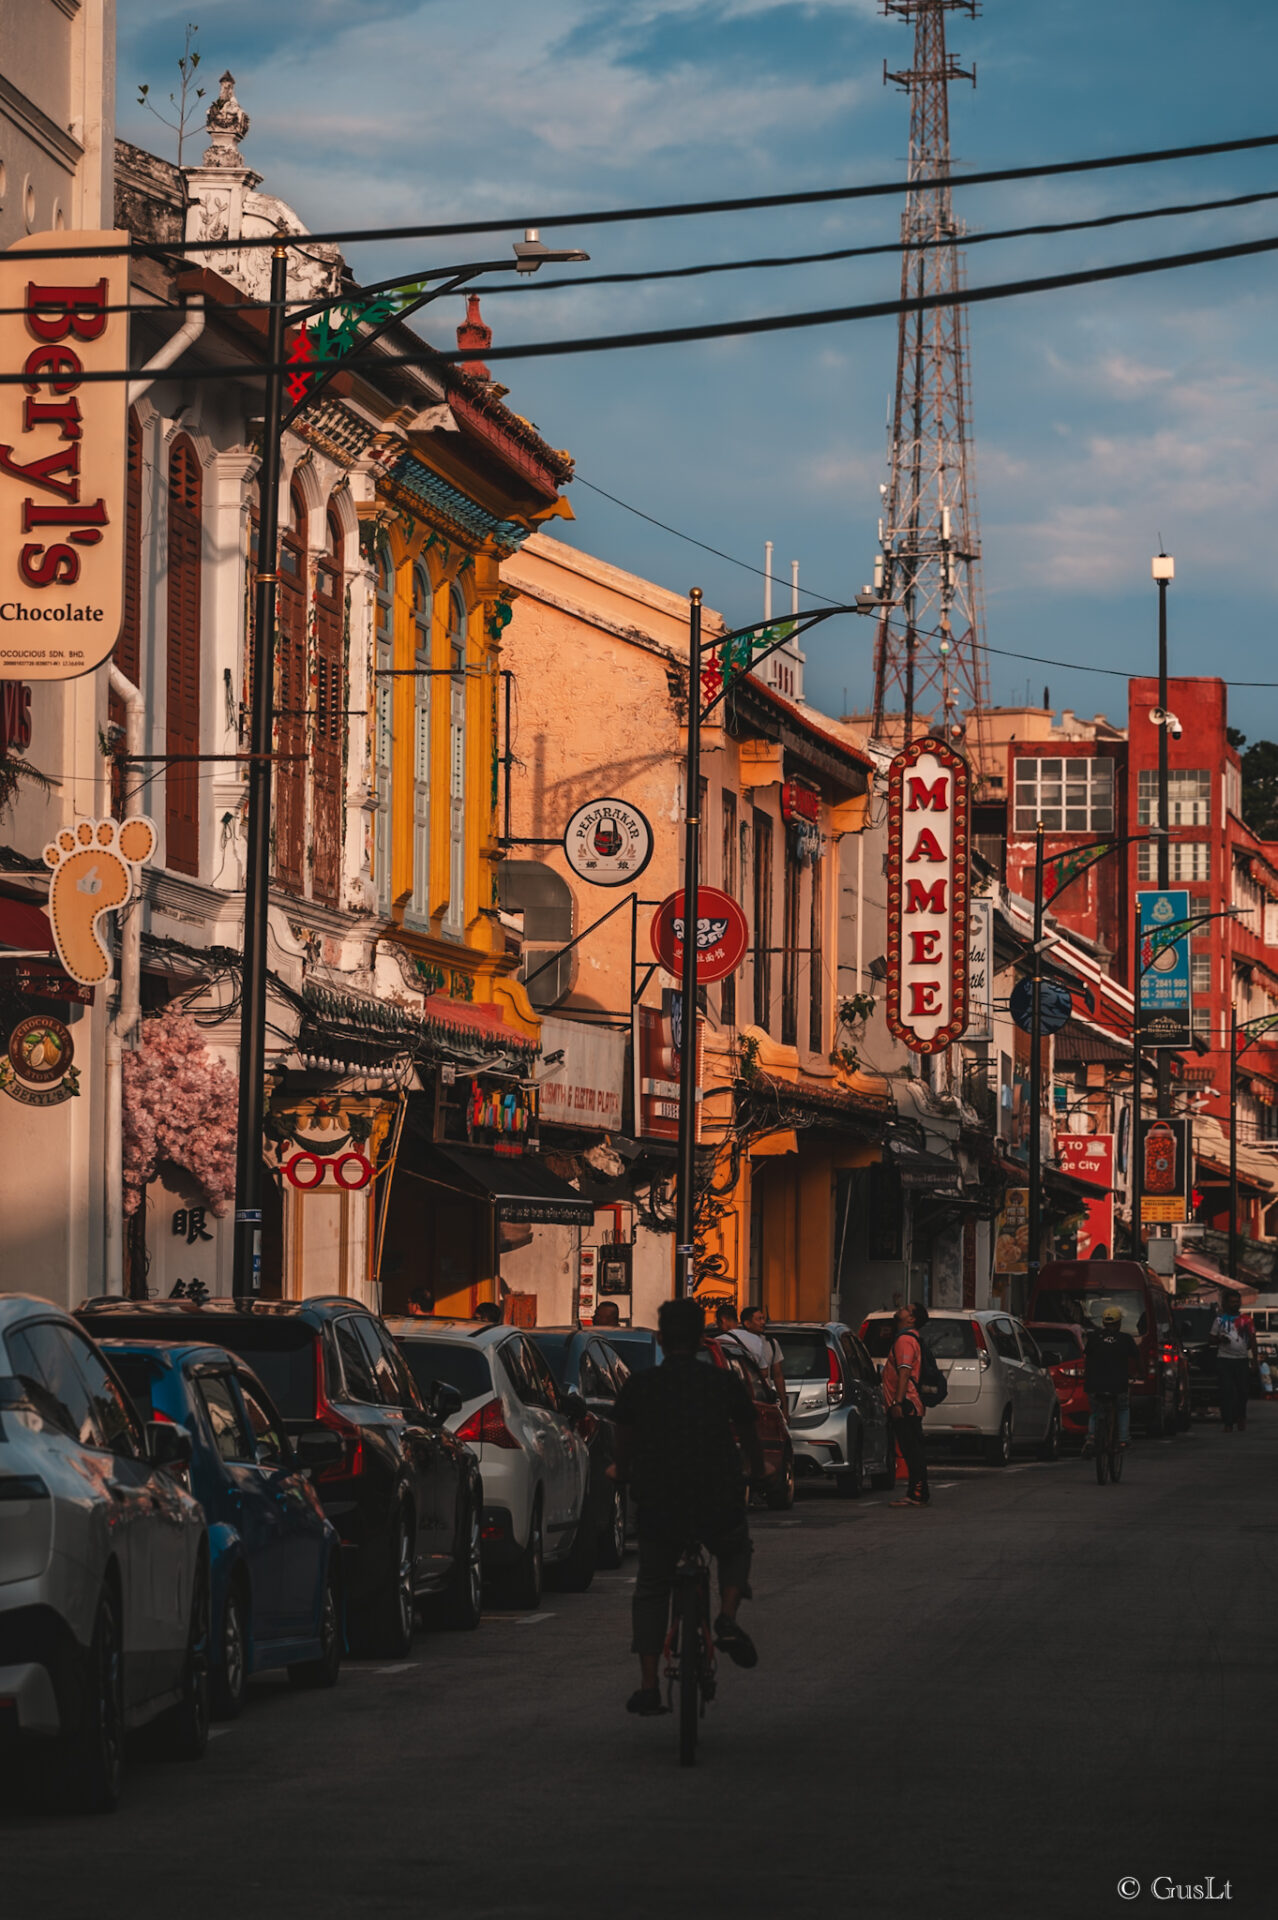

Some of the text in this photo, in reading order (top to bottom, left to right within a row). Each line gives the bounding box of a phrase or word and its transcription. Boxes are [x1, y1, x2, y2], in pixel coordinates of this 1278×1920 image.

[0, 277, 109, 587] Beryl's
[0, 602, 104, 622] Chocolate
[904, 776, 950, 1017] MAMEE
[1068, 1141, 1083, 1150] TO
[1078, 1161, 1100, 1172] City
